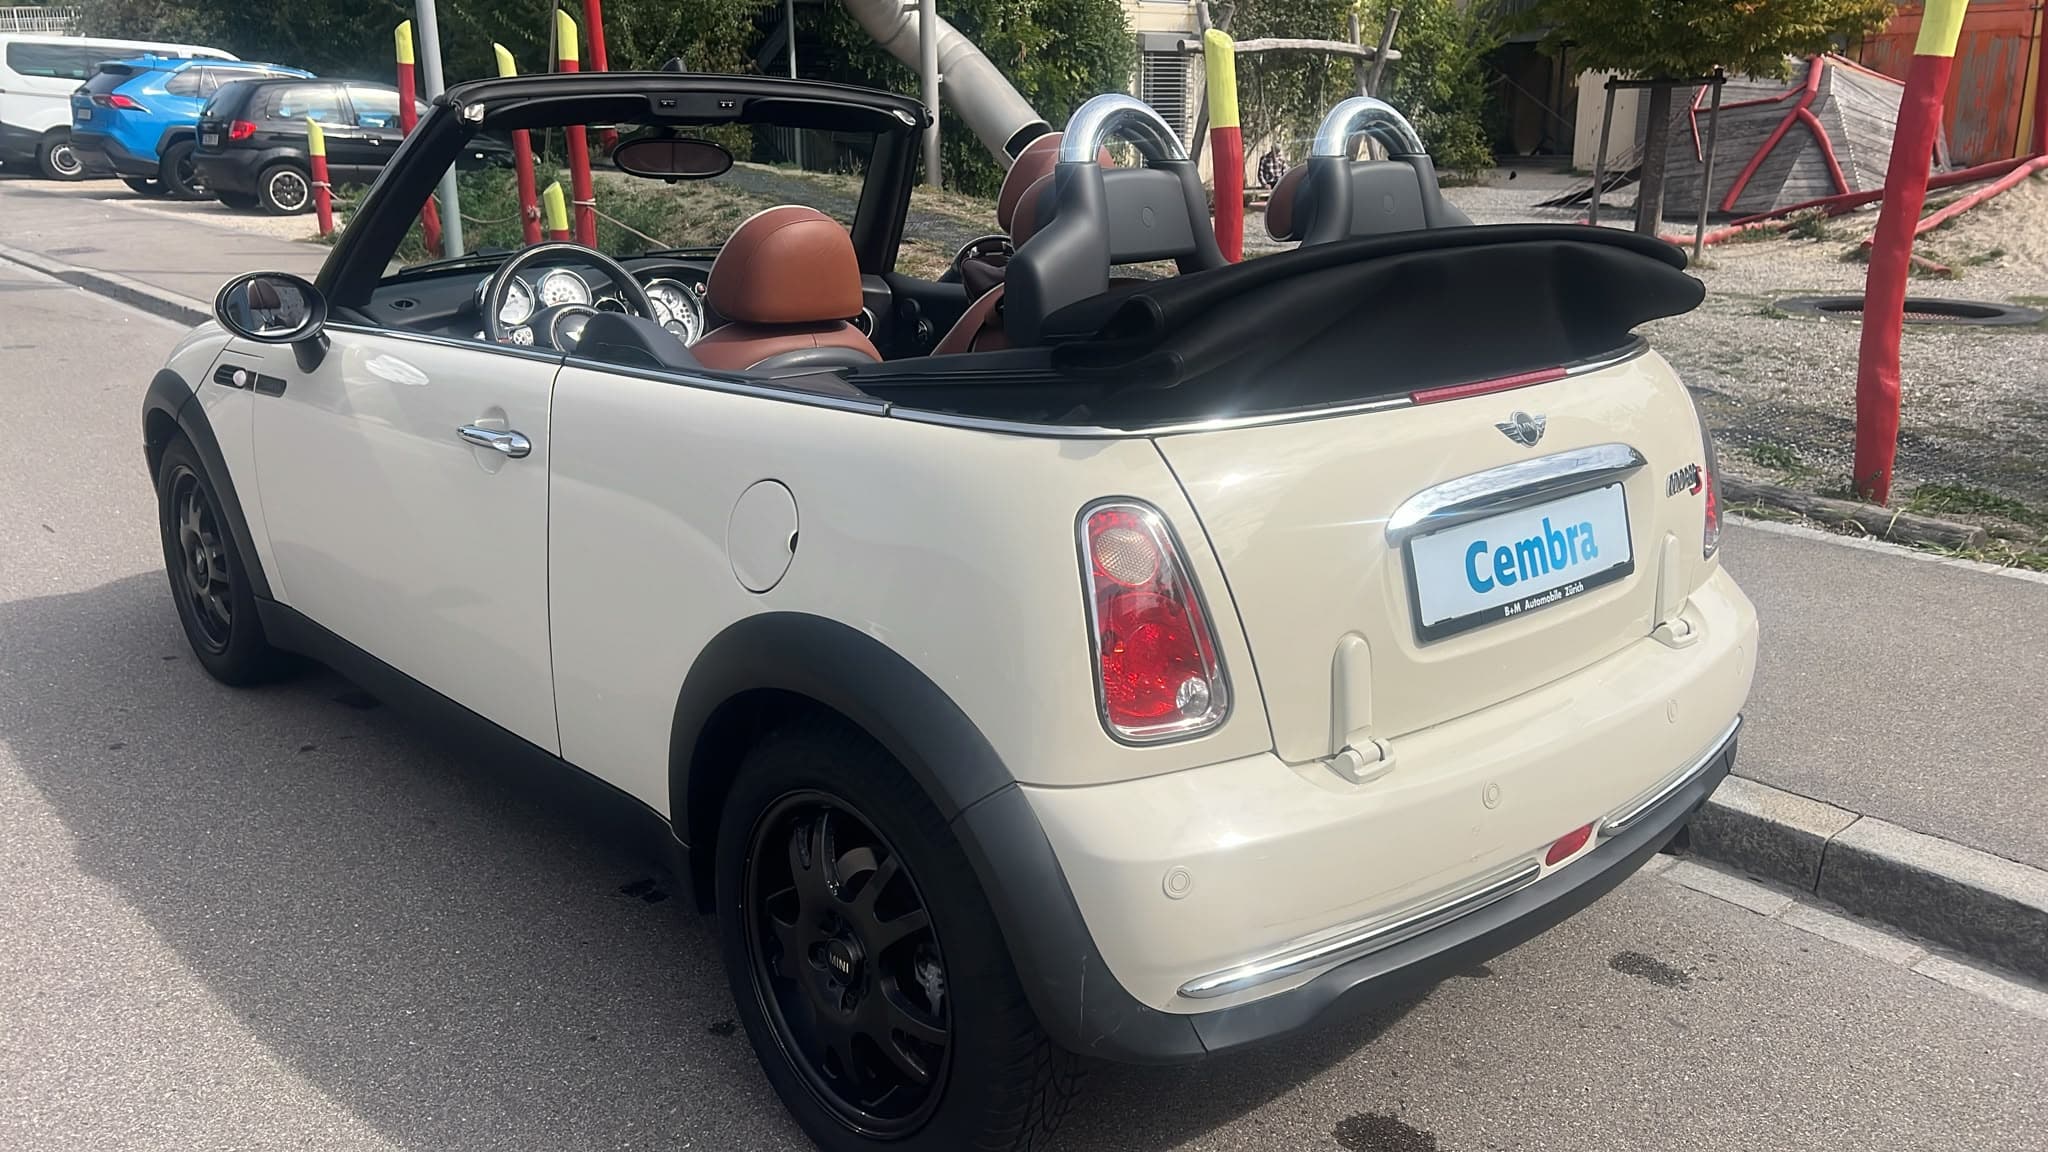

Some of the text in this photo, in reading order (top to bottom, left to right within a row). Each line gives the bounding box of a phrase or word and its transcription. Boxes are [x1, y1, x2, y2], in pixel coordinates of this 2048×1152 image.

[1465, 517, 1598, 593] Cembra
[1504, 581, 1584, 617] B+M Automobile Zürich
